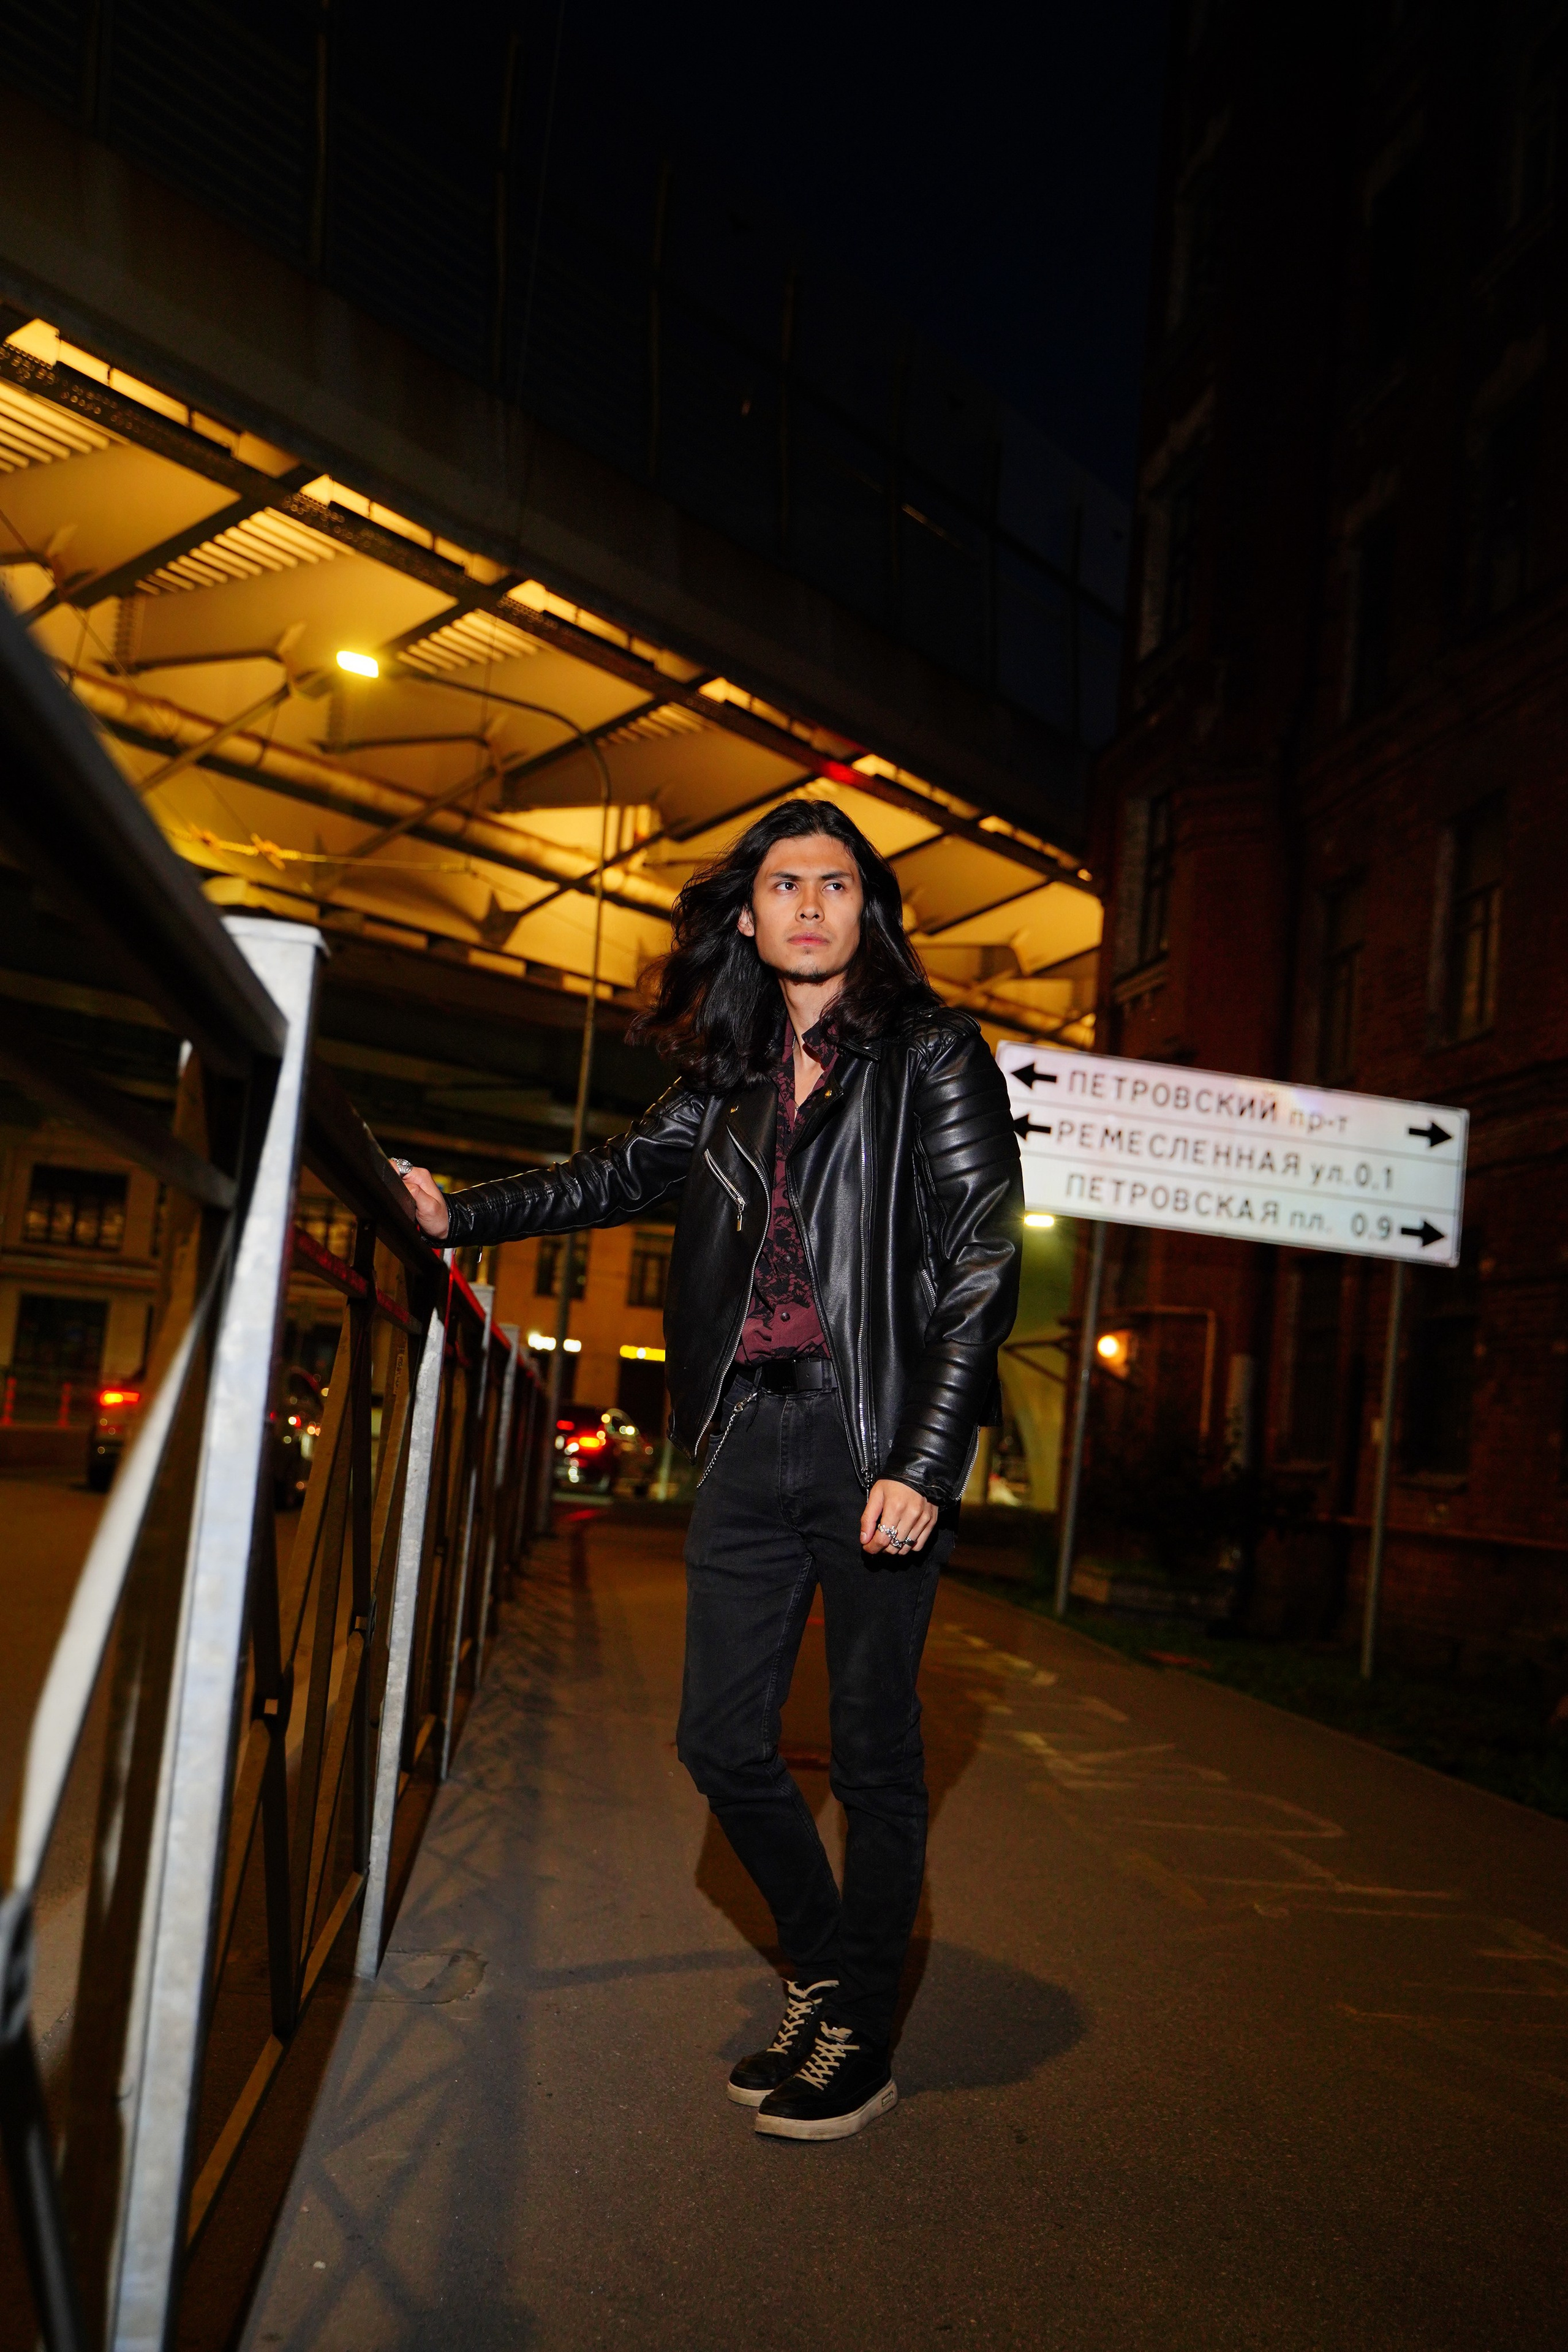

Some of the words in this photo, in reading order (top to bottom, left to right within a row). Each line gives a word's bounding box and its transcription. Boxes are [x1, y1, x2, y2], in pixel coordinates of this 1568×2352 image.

[1068, 1068, 1278, 1123] ПЕТРОВСКИЙ
[1290, 1110, 1347, 1133] пр-т
[1057, 1120, 1300, 1177] РЕМЕСЛЕННАЯ
[1066, 1173, 1278, 1224] ПЕТРОВСКАЯ
[1290, 1211, 1332, 1232] пл.
